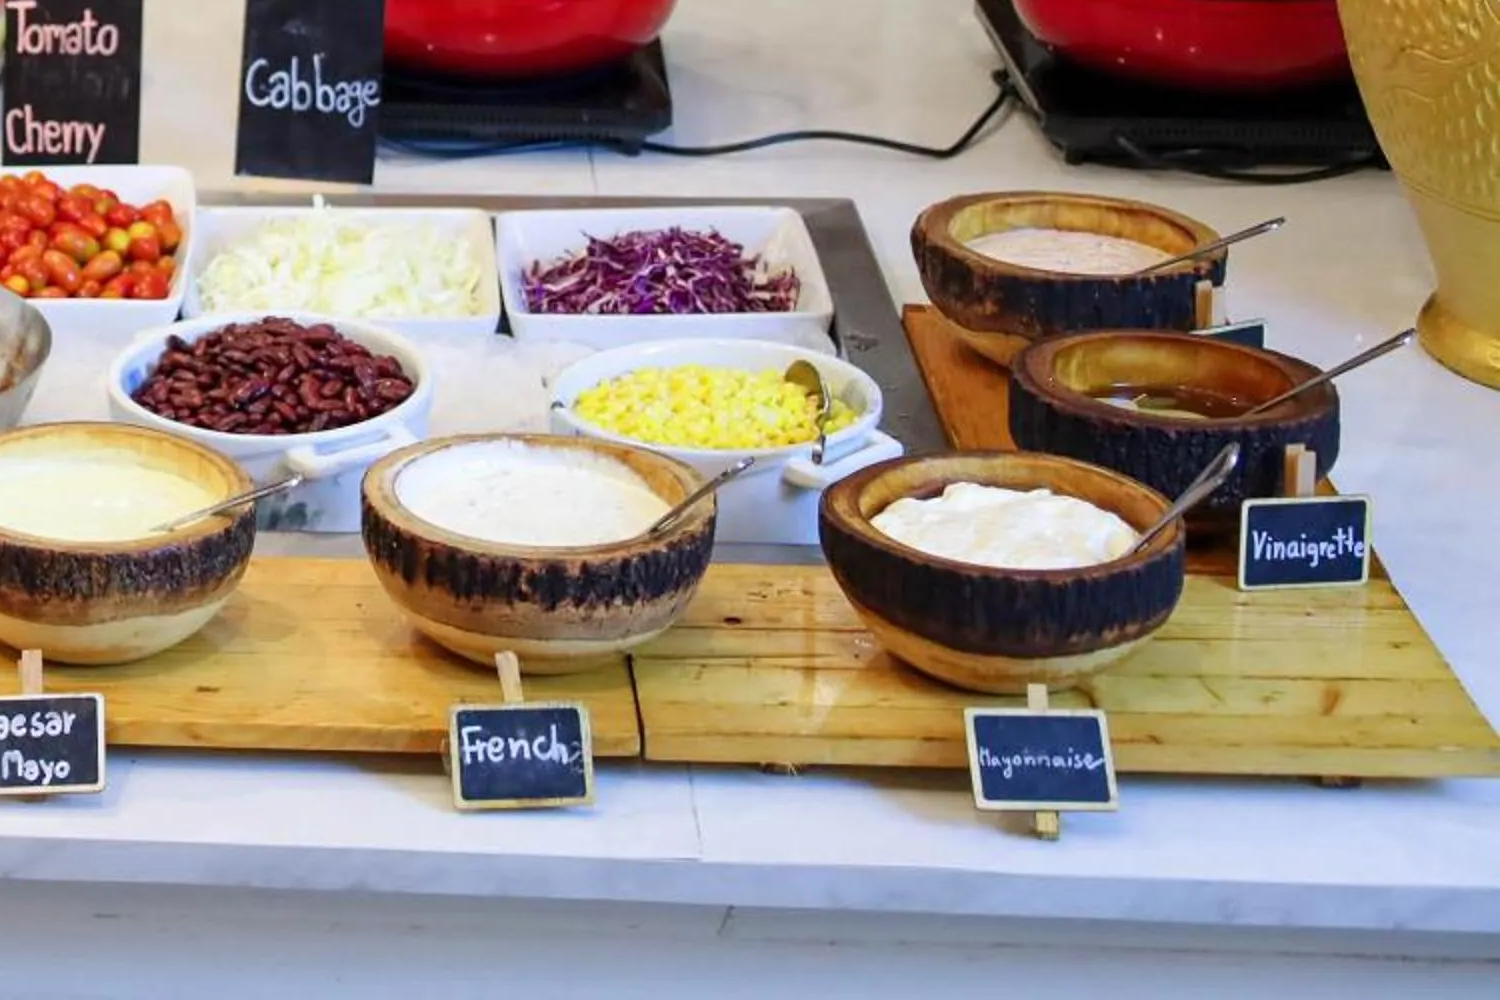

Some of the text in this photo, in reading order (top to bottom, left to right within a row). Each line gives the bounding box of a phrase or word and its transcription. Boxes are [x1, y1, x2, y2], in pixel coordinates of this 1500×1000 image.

[5, 0, 119, 56] Tomato
[245, 53, 380, 128] Cabbage
[5, 103, 106, 165] Cherry
[1252, 526, 1366, 568] Vinaigrette
[461, 723, 569, 765] French
[979, 747, 1105, 779] Mayonnaise
[1, 749, 71, 786] Mayo
